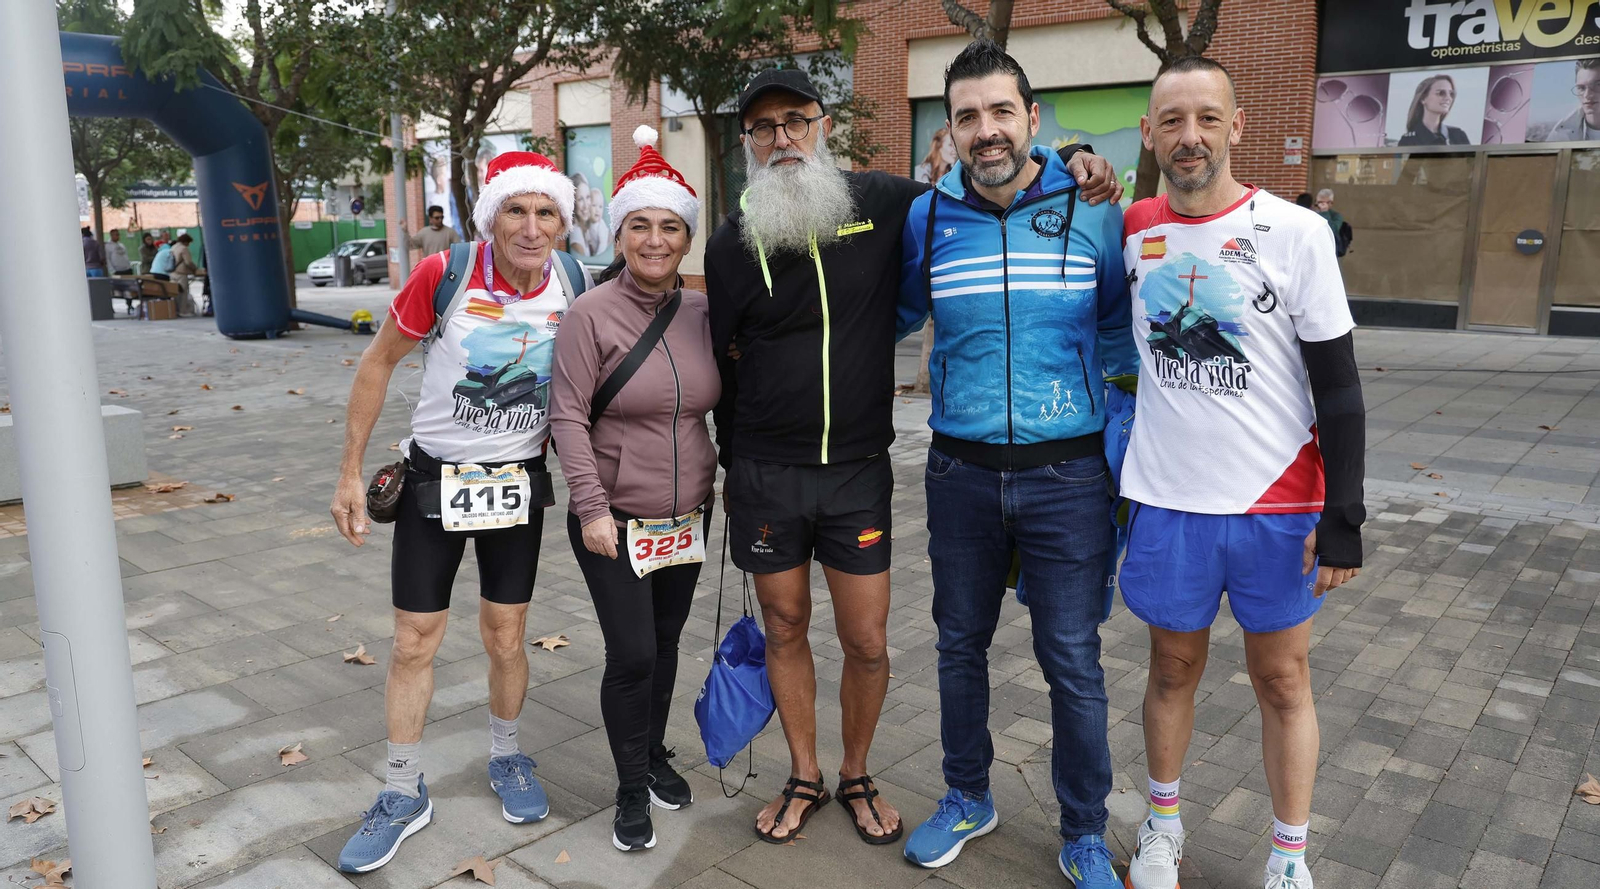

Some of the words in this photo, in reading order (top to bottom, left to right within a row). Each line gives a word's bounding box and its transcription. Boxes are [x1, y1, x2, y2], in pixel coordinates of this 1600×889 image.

[1404, 0, 1600, 50] traver
[1431, 41, 1521, 59] optometristas
[1154, 350, 1181, 380] Vive
[1184, 353, 1201, 385] la
[1204, 356, 1248, 391] vida
[1178, 380, 1187, 390] de
[452, 394, 484, 425] Vive
[484, 404, 502, 429] la
[505, 403, 541, 431] vida
[450, 485, 522, 513] 415
[635, 527, 692, 560] 325
[1151, 789, 1176, 797] 226ERS
[1276, 830, 1303, 842] 226ERS
